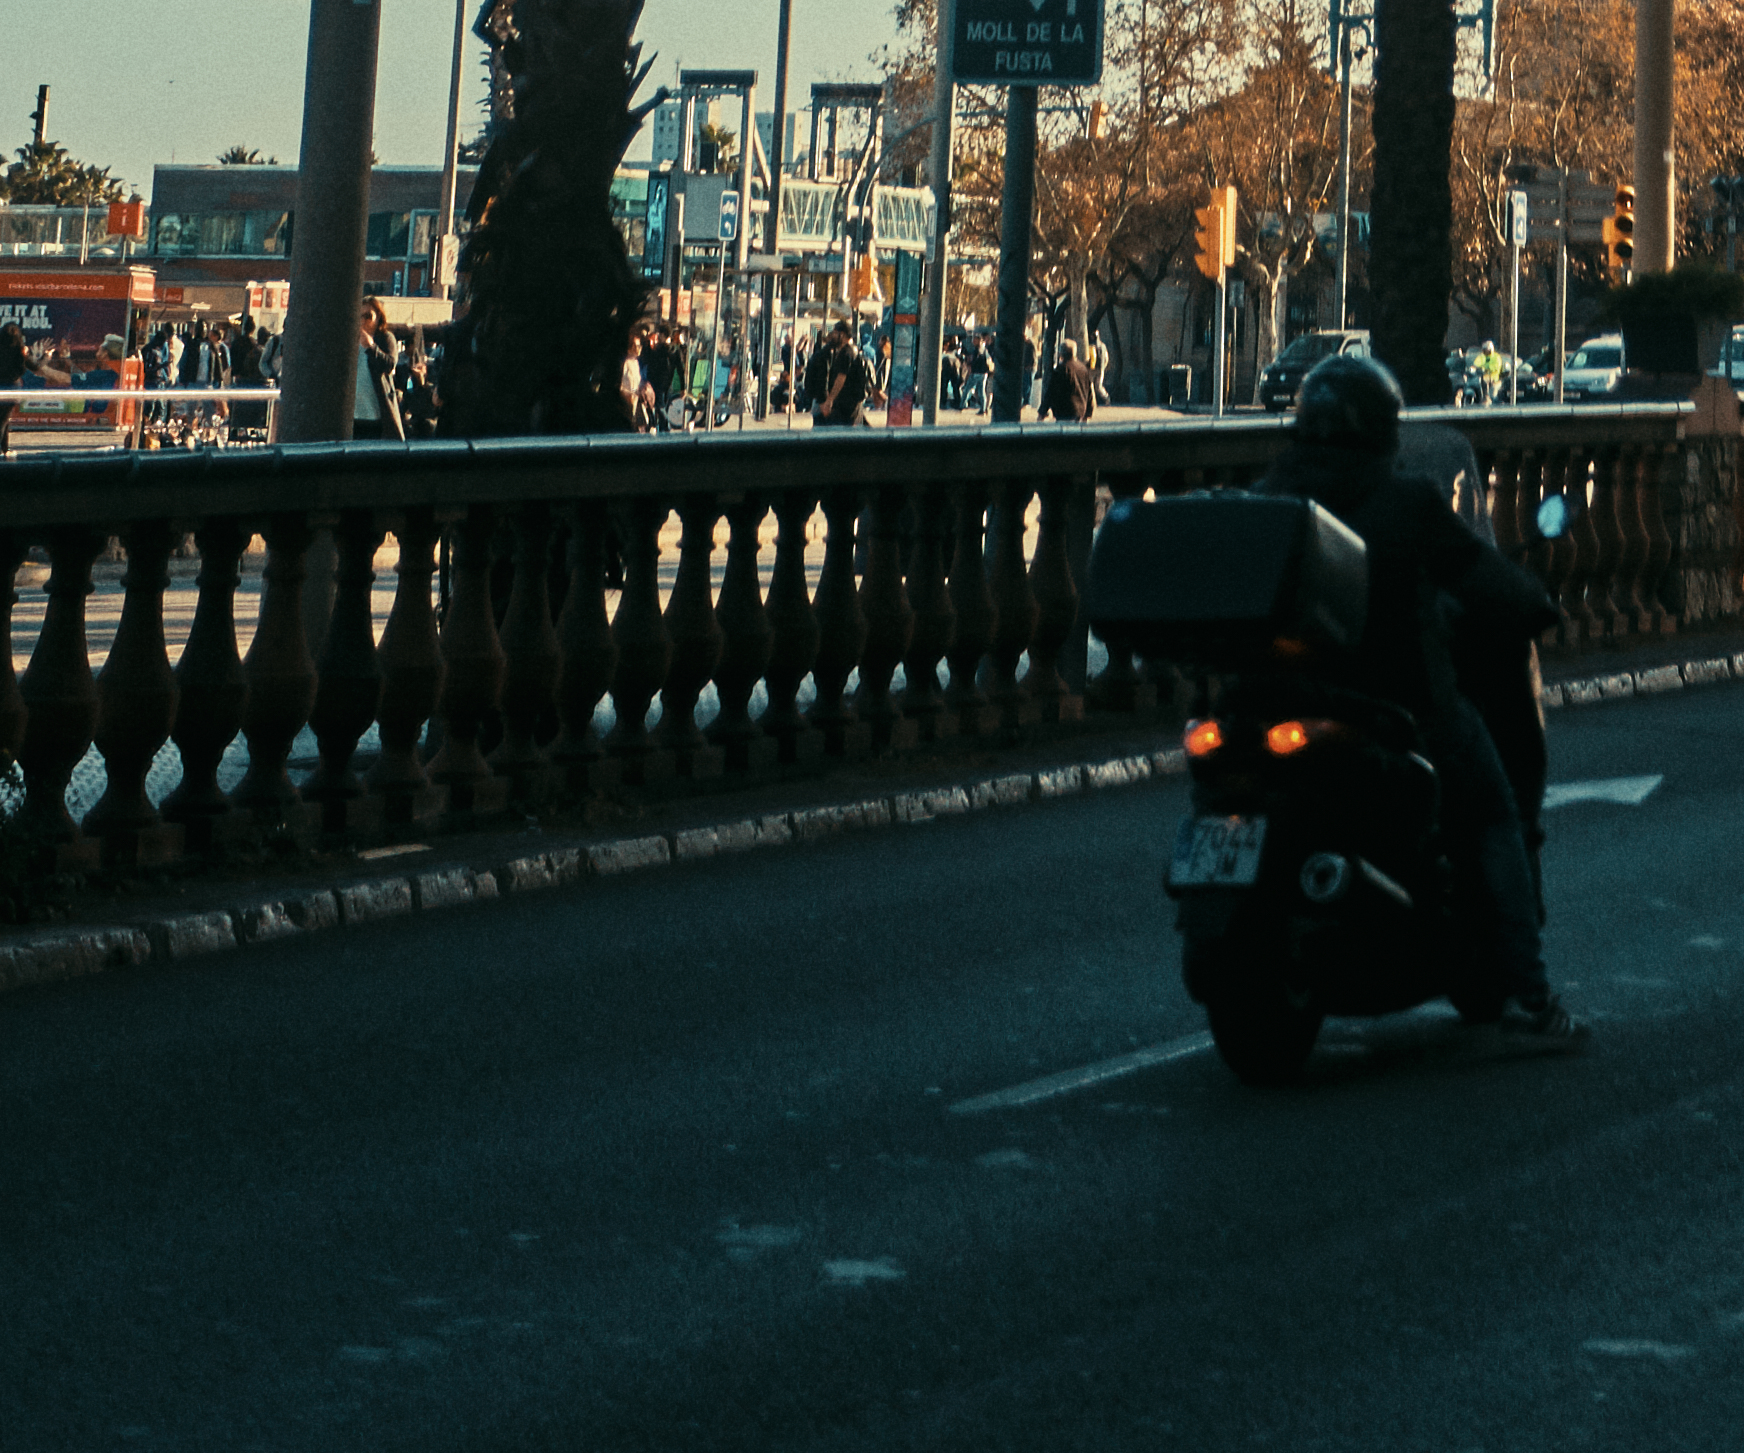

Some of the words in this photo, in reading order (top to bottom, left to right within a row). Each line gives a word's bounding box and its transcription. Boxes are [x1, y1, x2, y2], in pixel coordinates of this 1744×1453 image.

[966, 20, 1018, 43] MOLL
[1026, 22, 1050, 43] DE
[1060, 22, 1085, 44] LA
[994, 50, 1052, 72] FUSTA
[30, 304, 48, 317] AT
